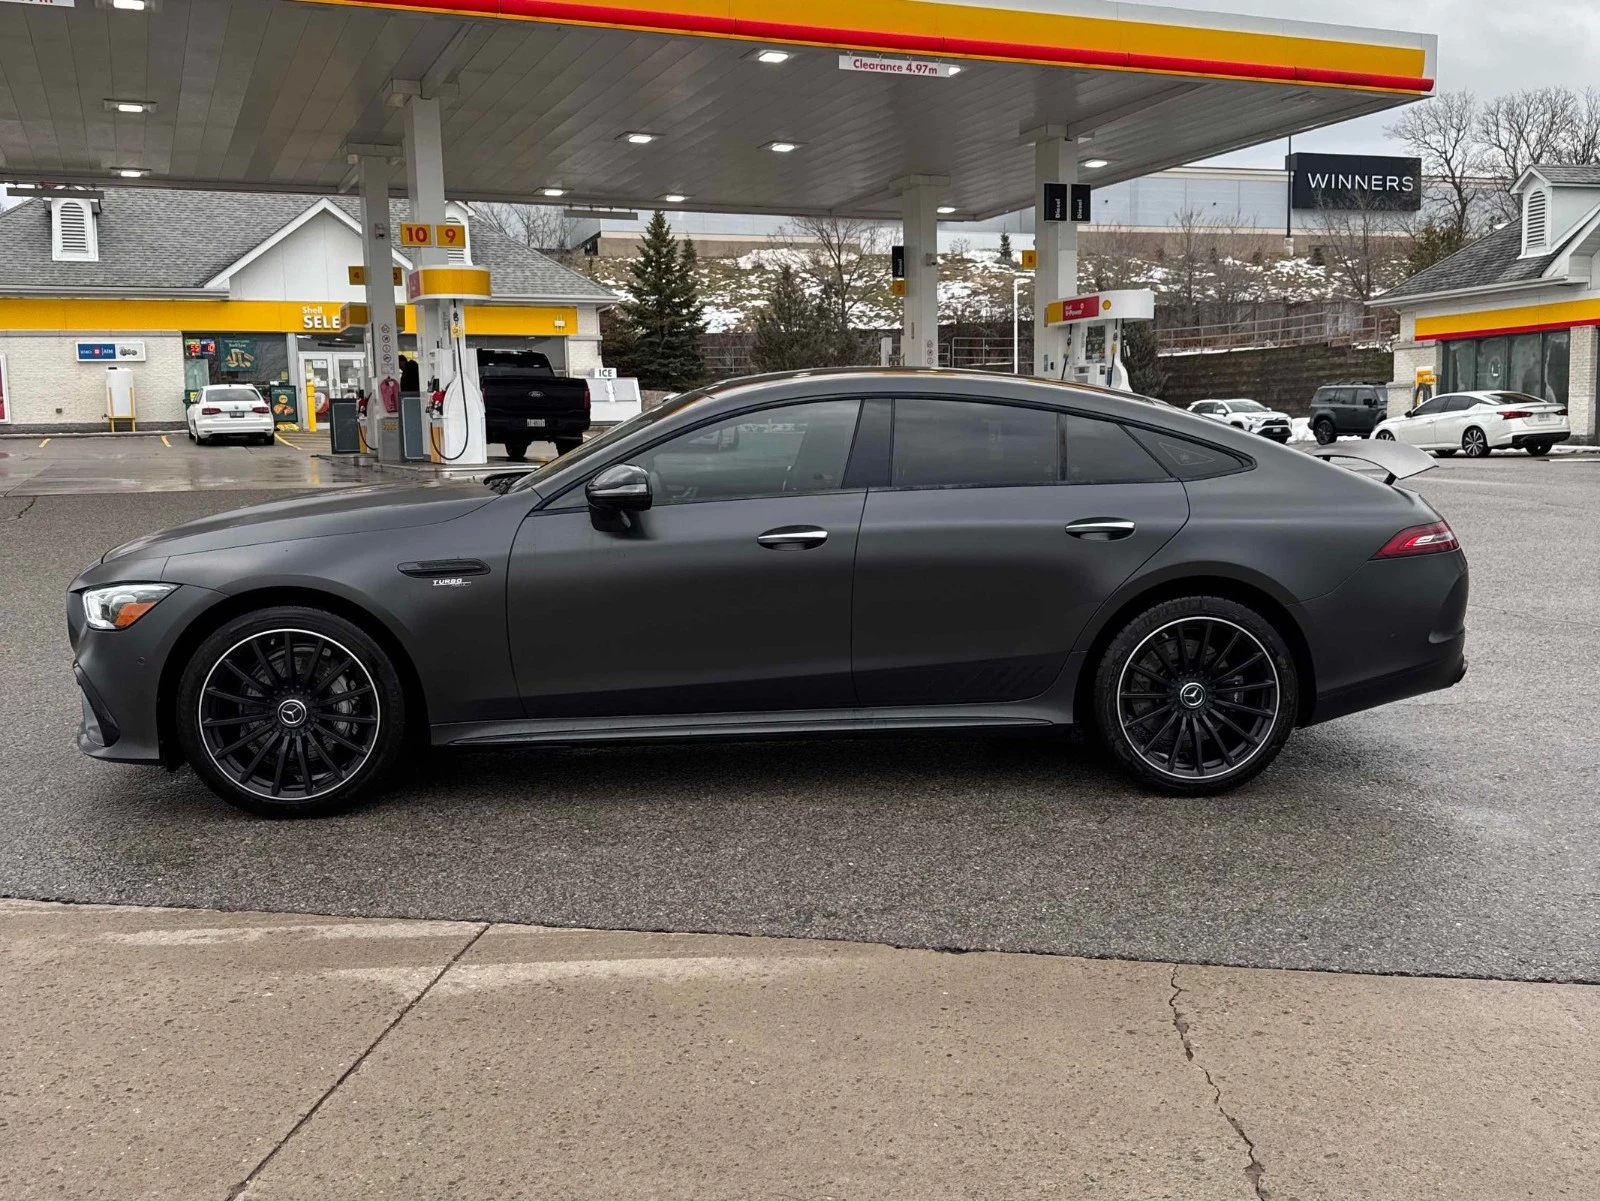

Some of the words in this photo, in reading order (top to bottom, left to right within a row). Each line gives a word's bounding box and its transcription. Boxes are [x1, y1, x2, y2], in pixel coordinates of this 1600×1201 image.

[853, 58, 903, 73] Clearance
[905, 62, 938, 75] 4.97m
[1307, 172, 1414, 192] WINNERS
[406, 226, 428, 243] 10
[444, 228, 457, 243] 9
[353, 271, 360, 279] 4
[302, 305, 323, 314] Shell
[303, 314, 340, 329] SELE
[598, 368, 613, 378] ICE
[432, 578, 463, 586] TURBO
